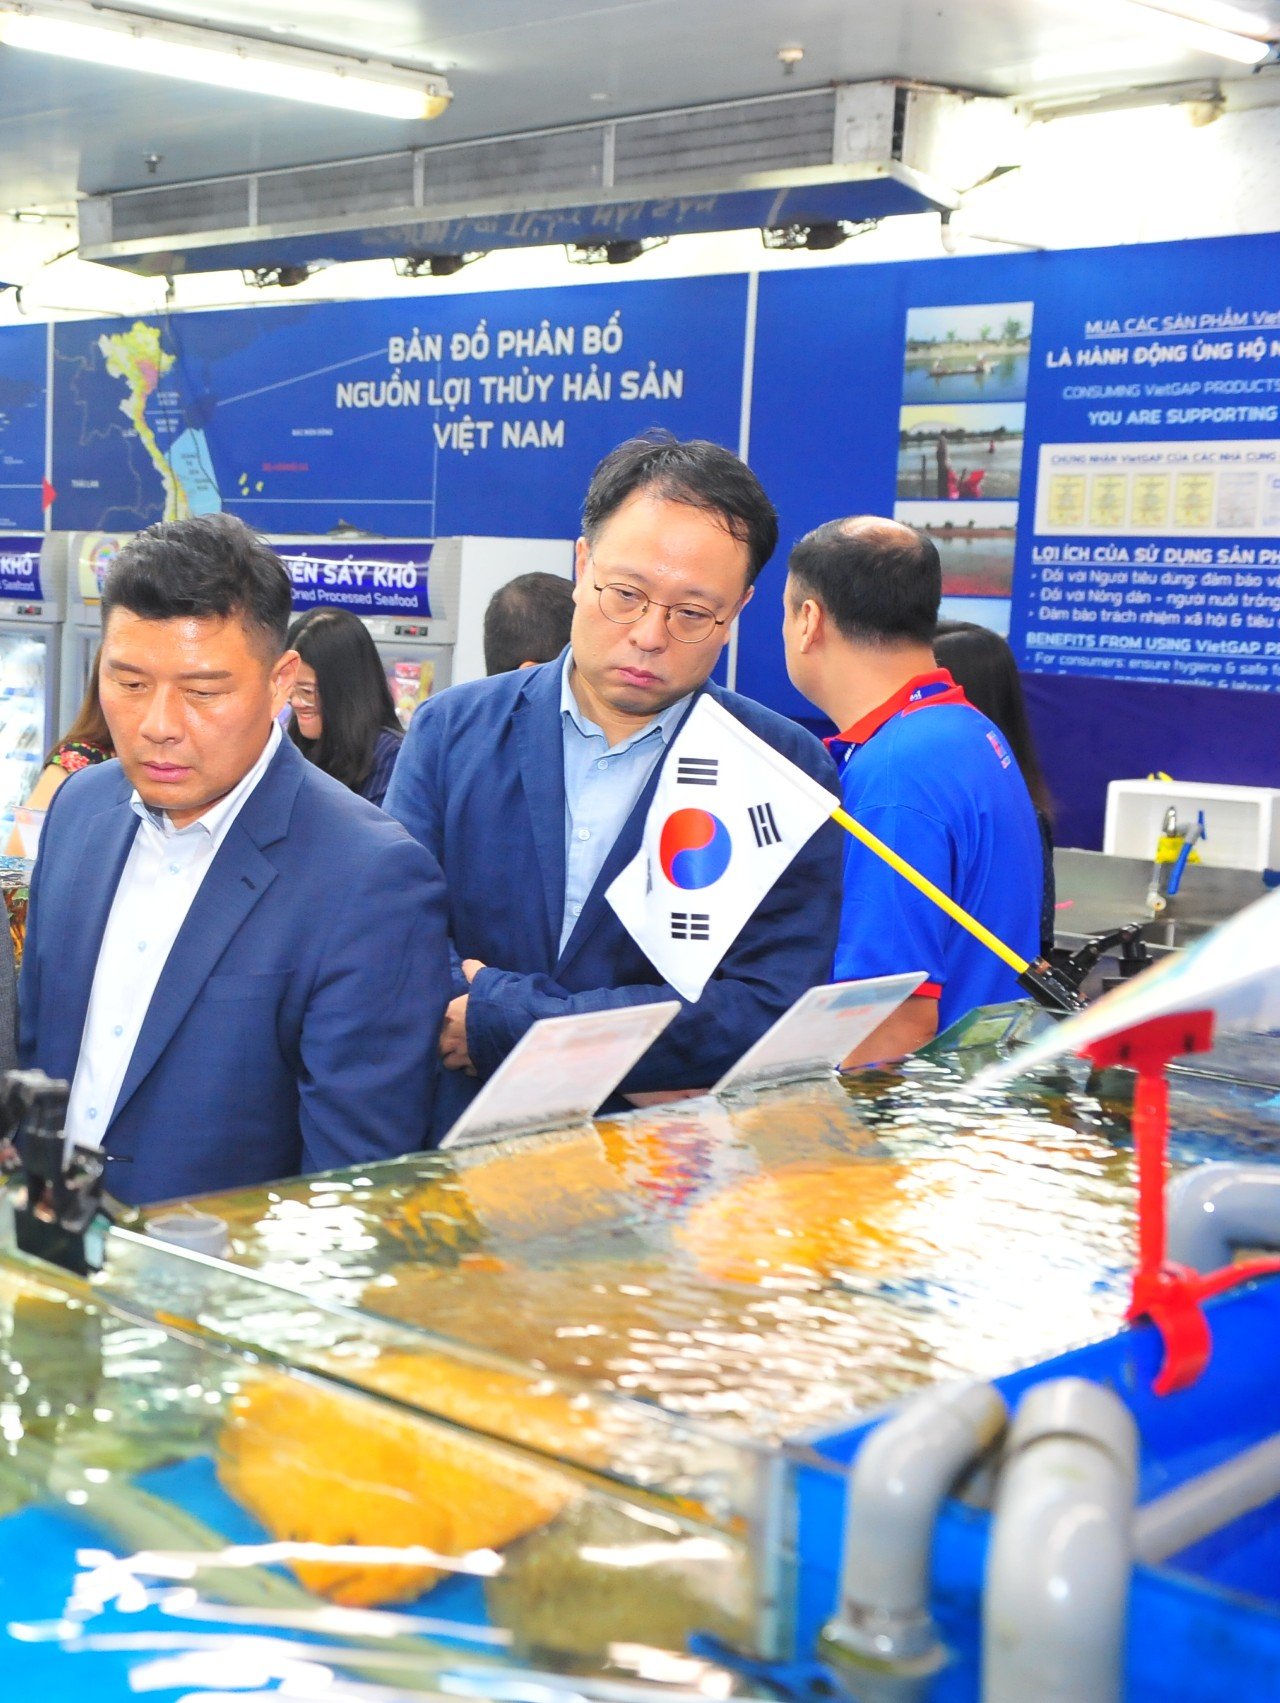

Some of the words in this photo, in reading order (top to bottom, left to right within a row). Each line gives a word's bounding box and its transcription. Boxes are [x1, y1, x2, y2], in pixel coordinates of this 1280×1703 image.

[1085, 320, 1120, 334] MUA
[1124, 315, 1159, 332] CÁC
[1162, 312, 1197, 330] SẢN
[1199, 306, 1249, 328] PHẨM
[388, 327, 442, 364] BẢN
[450, 319, 490, 361] ĐỒ
[497, 320, 575, 358] PHÂN
[583, 309, 623, 355] BỐ
[1046, 346, 1072, 368] LÀ
[1076, 345, 1129, 367] HÀNH
[1133, 341, 1188, 367] ĐỘNG
[1237, 336, 1267, 362] HỘ
[336, 368, 421, 409] NGUỒN
[427, 377, 471, 411] LỢI
[479, 367, 555, 404] THỦY
[562, 362, 611, 402] HẢI
[620, 360, 685, 400] SẢN
[1063, 384, 1141, 400] CONSUMING
[1144, 381, 1201, 397] VietGAP
[1088, 410, 1123, 426] YOU
[1125, 408, 1162, 425] ARE
[1166, 405, 1278, 424] SUPPORTING
[433, 414, 494, 456] VIỆT
[501, 420, 565, 450] NAM
[0, 552, 34, 577] KHÔ
[1032, 546, 1060, 563] LỢI
[1062, 543, 1090, 561] ÍCH
[1093, 543, 1130, 562] CỦA
[1163, 547, 1214, 566] DỤNG
[1217, 545, 1255, 564] SẢN
[372, 560, 418, 589] KHÔ
[317, 589, 373, 605] Processed
[374, 592, 419, 609] Seafood
[1026, 631, 1096, 649] BENEFITS
[1099, 634, 1142, 651] FROM
[1145, 636, 1191, 653] USING
[1195, 639, 1261, 655] VietGAP
[1034, 651, 1056, 664] For
[1128, 658, 1171, 671] ensure
[1239, 662, 1268, 676] safe
